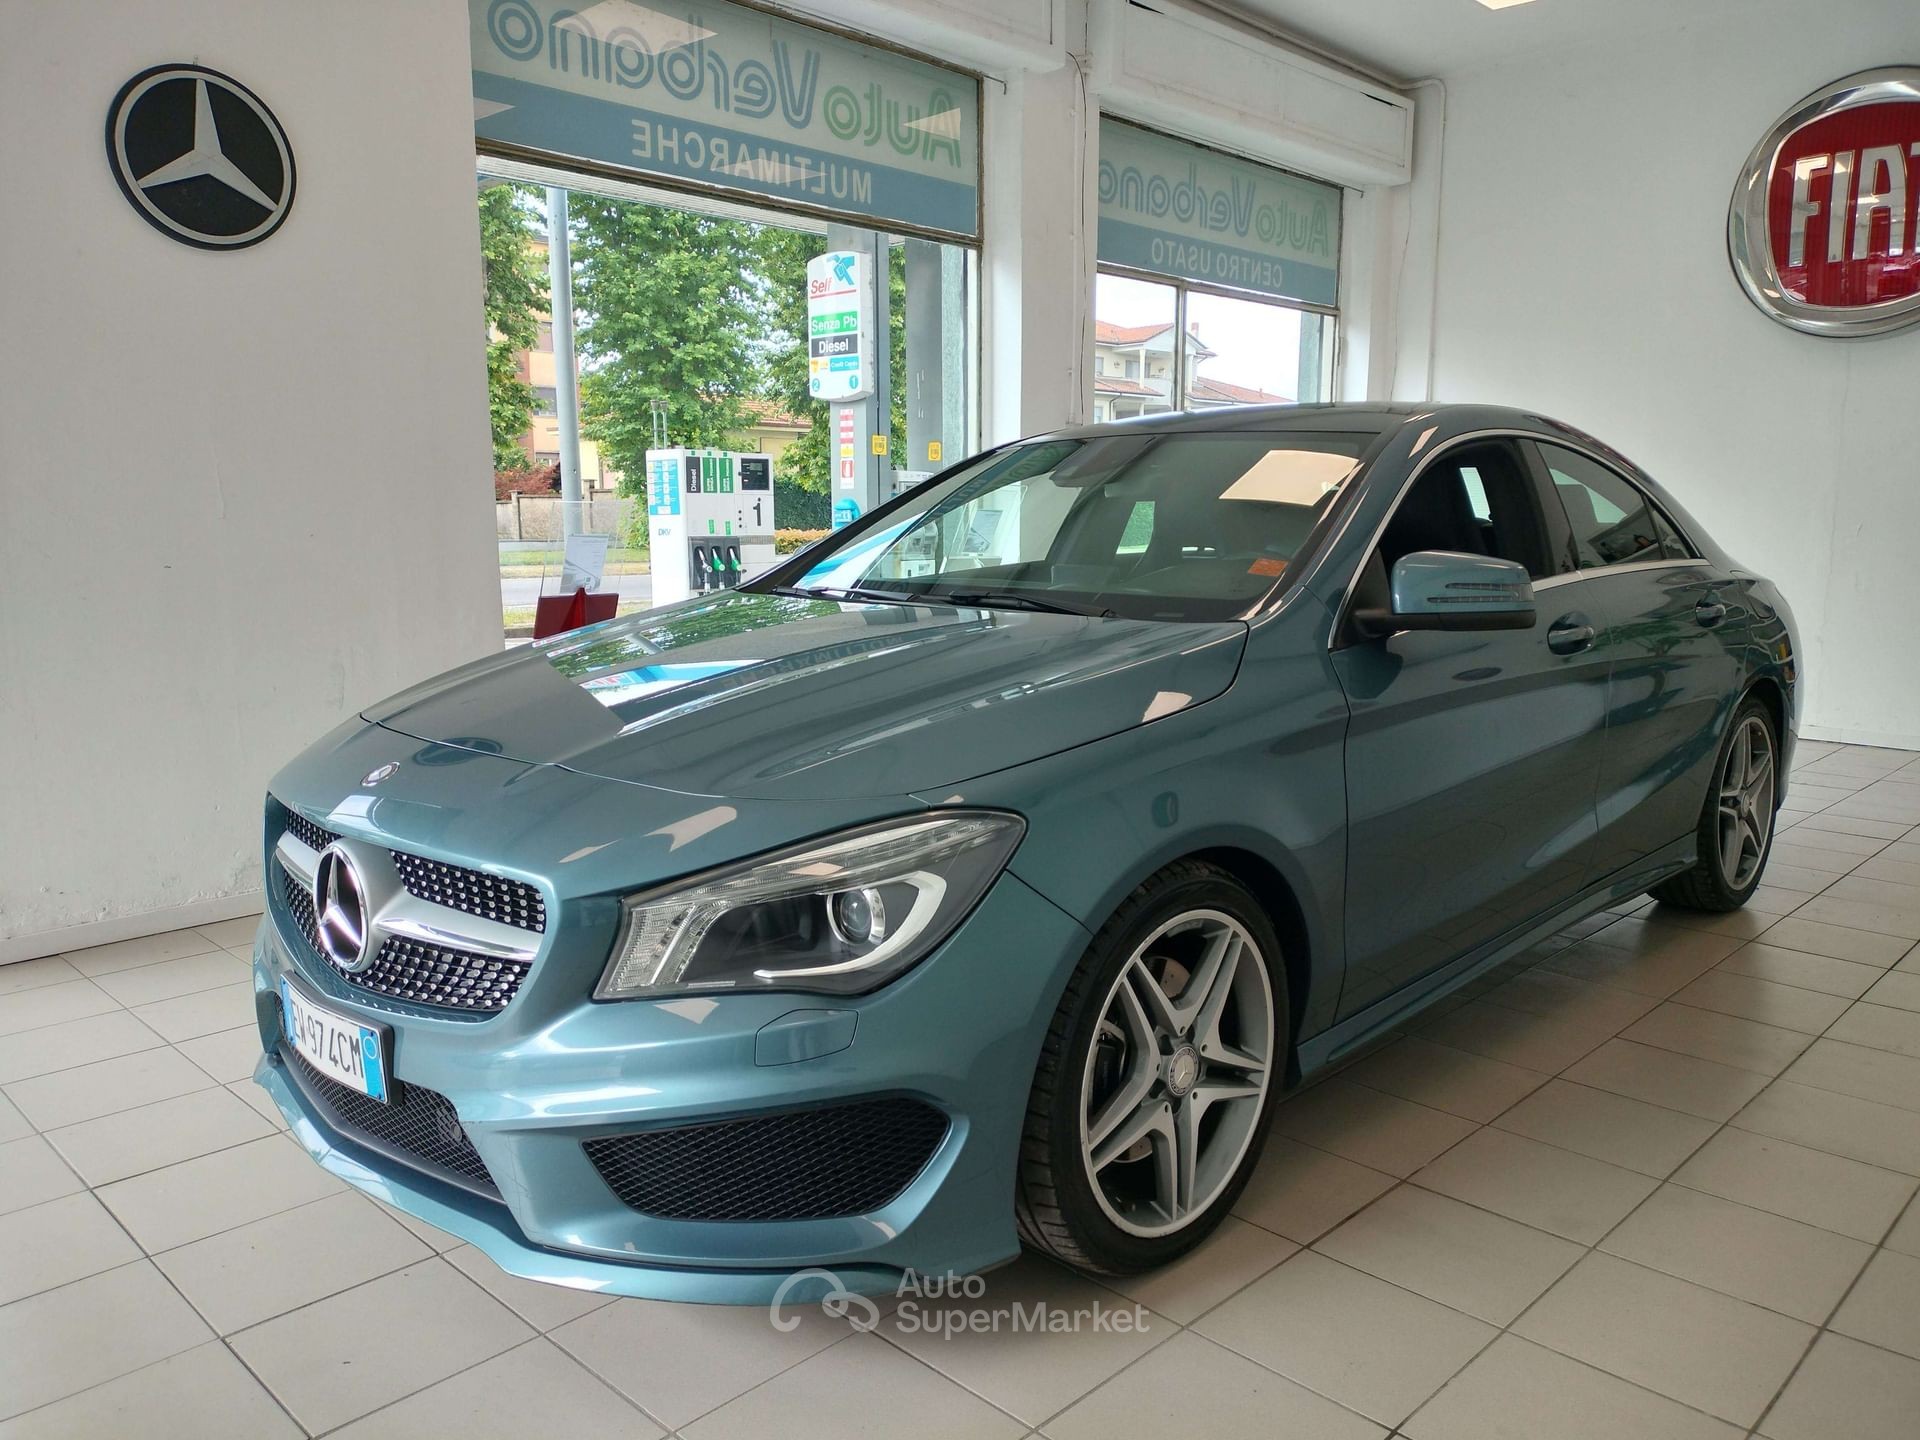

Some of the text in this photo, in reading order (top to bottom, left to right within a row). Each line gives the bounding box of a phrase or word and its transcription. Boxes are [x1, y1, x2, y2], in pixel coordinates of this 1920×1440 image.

[1788, 142, 1920, 268] FIA
[810, 277, 833, 295] Self
[811, 315, 857, 332] Senza Pb
[818, 338, 849, 354] Diesel
